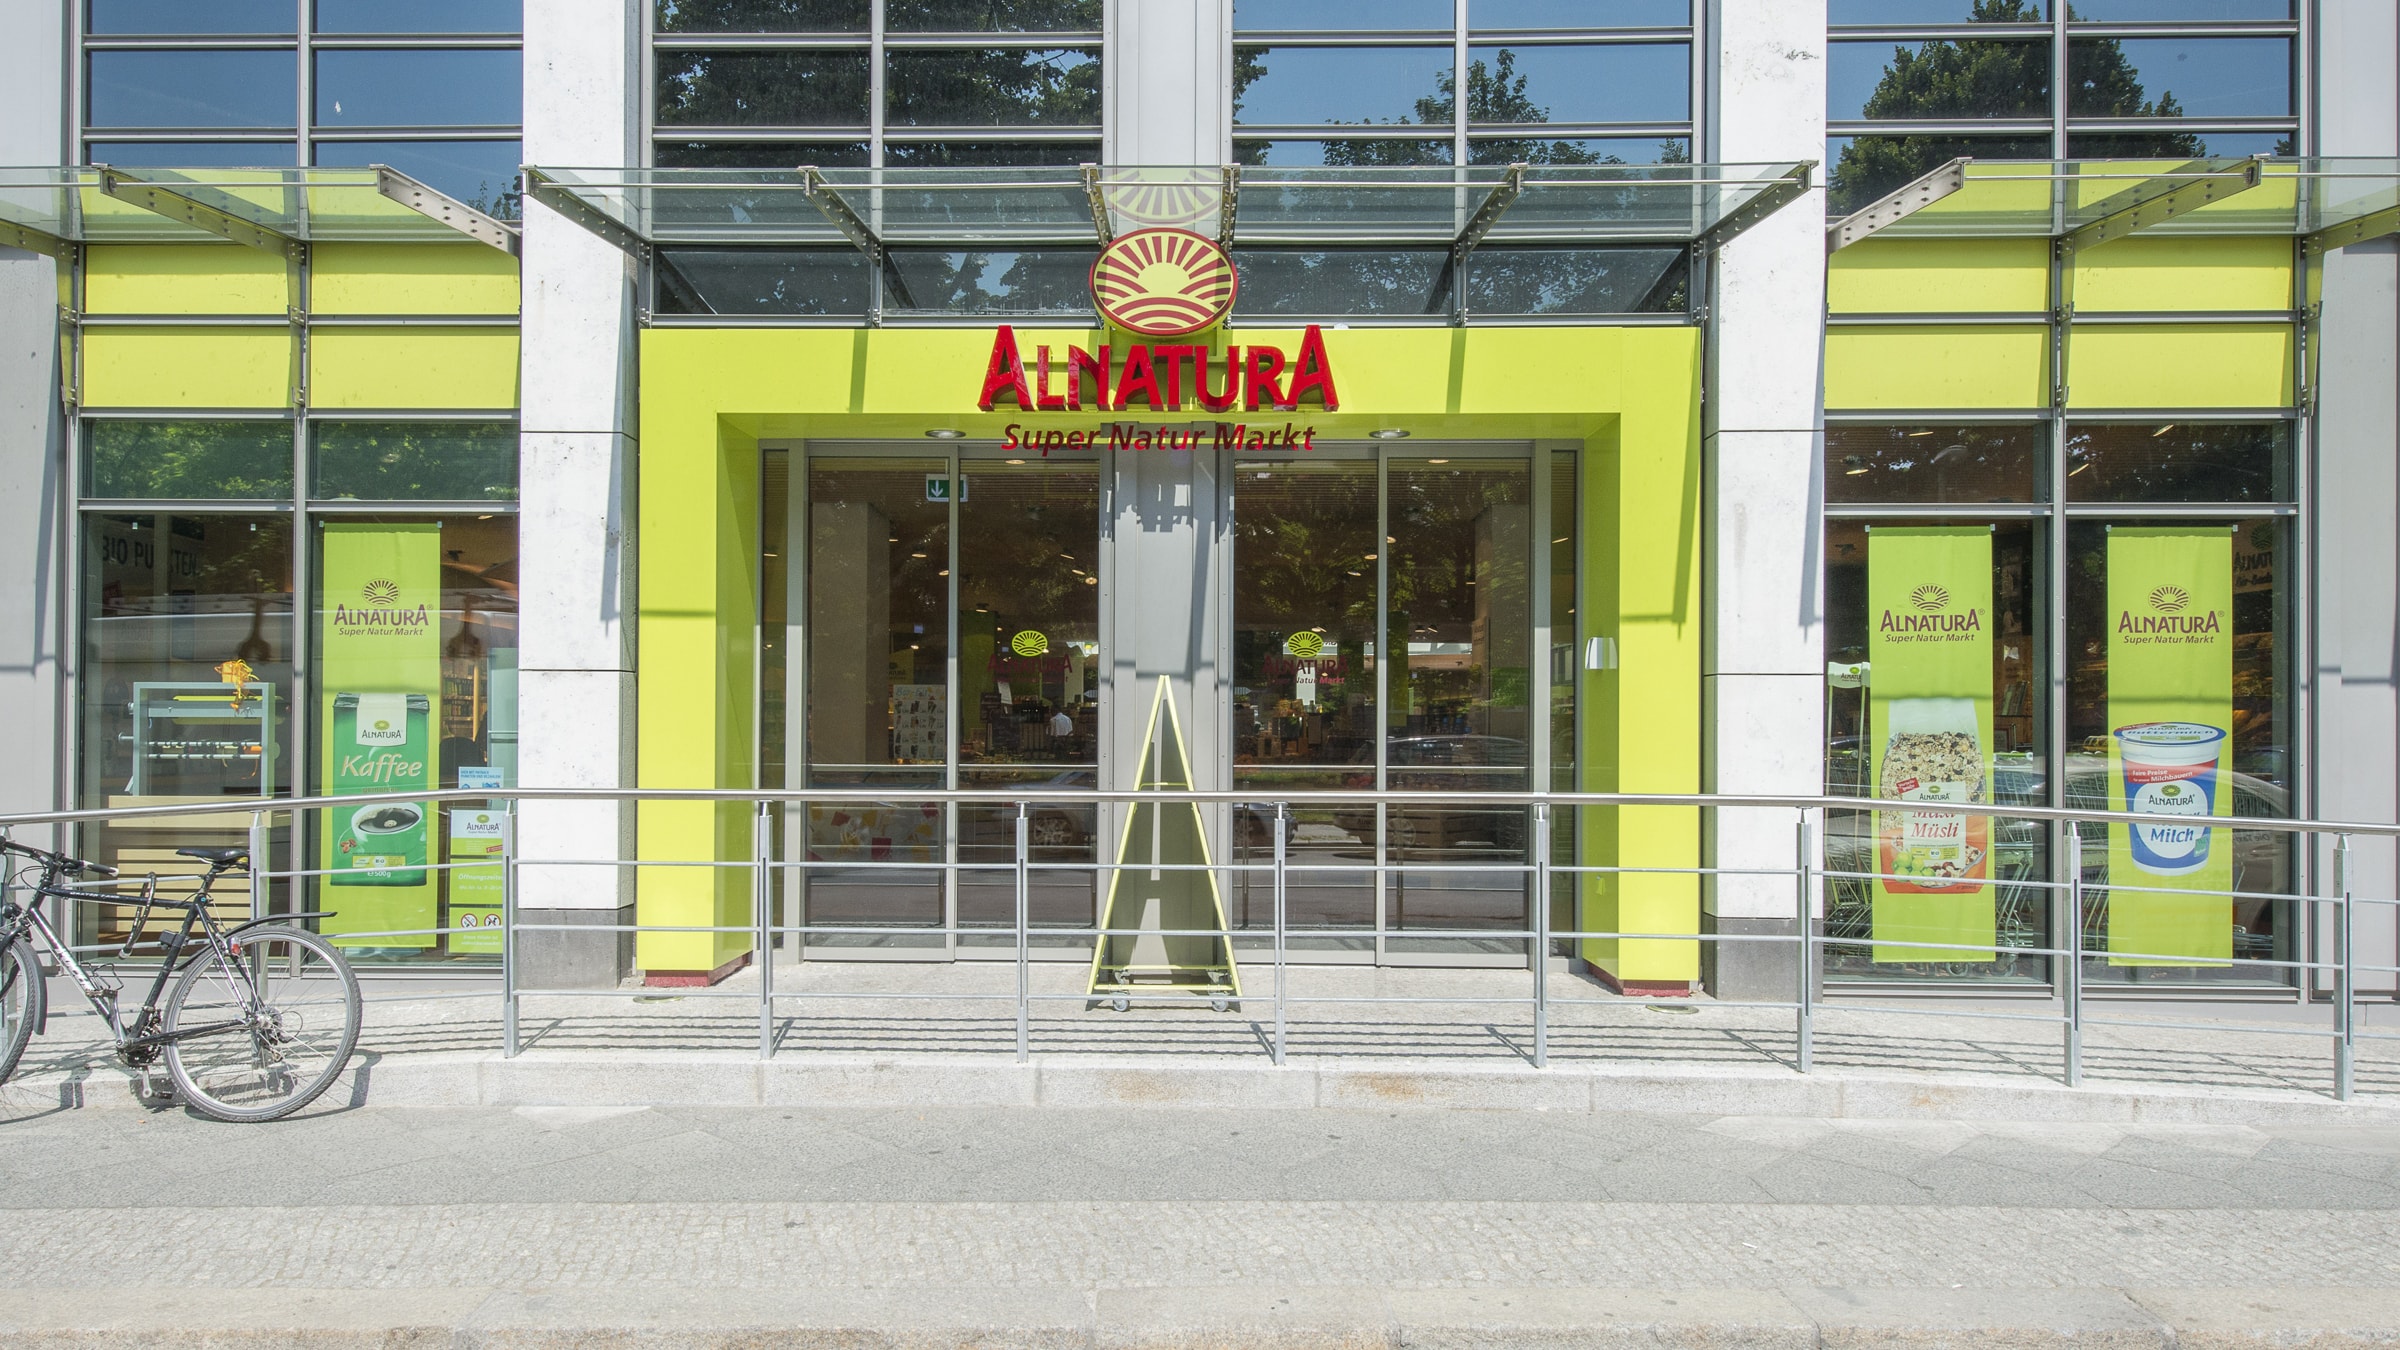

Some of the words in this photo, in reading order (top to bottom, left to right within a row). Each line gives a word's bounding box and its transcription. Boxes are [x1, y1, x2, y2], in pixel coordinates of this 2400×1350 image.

[977, 325, 1339, 413] ALNATURA
[1001, 423, 1100, 457] Super
[1108, 425, 1205, 451] Natur
[1213, 423, 1316, 451] Markt
[333, 603, 429, 626] ALNATURA
[1880, 608, 1980, 632] ALNATURA
[2118, 610, 2220, 633] ALNATURA
[338, 627, 365, 637] Super
[366, 627, 393, 636] Natur
[394, 627, 424, 636] Markt
[1885, 633, 1914, 644] Super
[1916, 633, 1944, 642] Natur
[1946, 633, 1975, 642] Markt
[2123, 635, 2152, 645] Super
[2154, 635, 2183, 644] Natur
[2185, 635, 2214, 644] Markt
[361, 729, 402, 739] ALNATURA
[340, 752, 423, 783] Kaffee
[2150, 771, 2193, 782] Milchbauern
[2148, 794, 2194, 806] ALNATURA
[466, 822, 500, 831] ALNATURA
[1911, 822, 1959, 838] Müsli
[2150, 827, 2194, 843] Milch
[458, 873, 503, 881] Öffnungszeite
